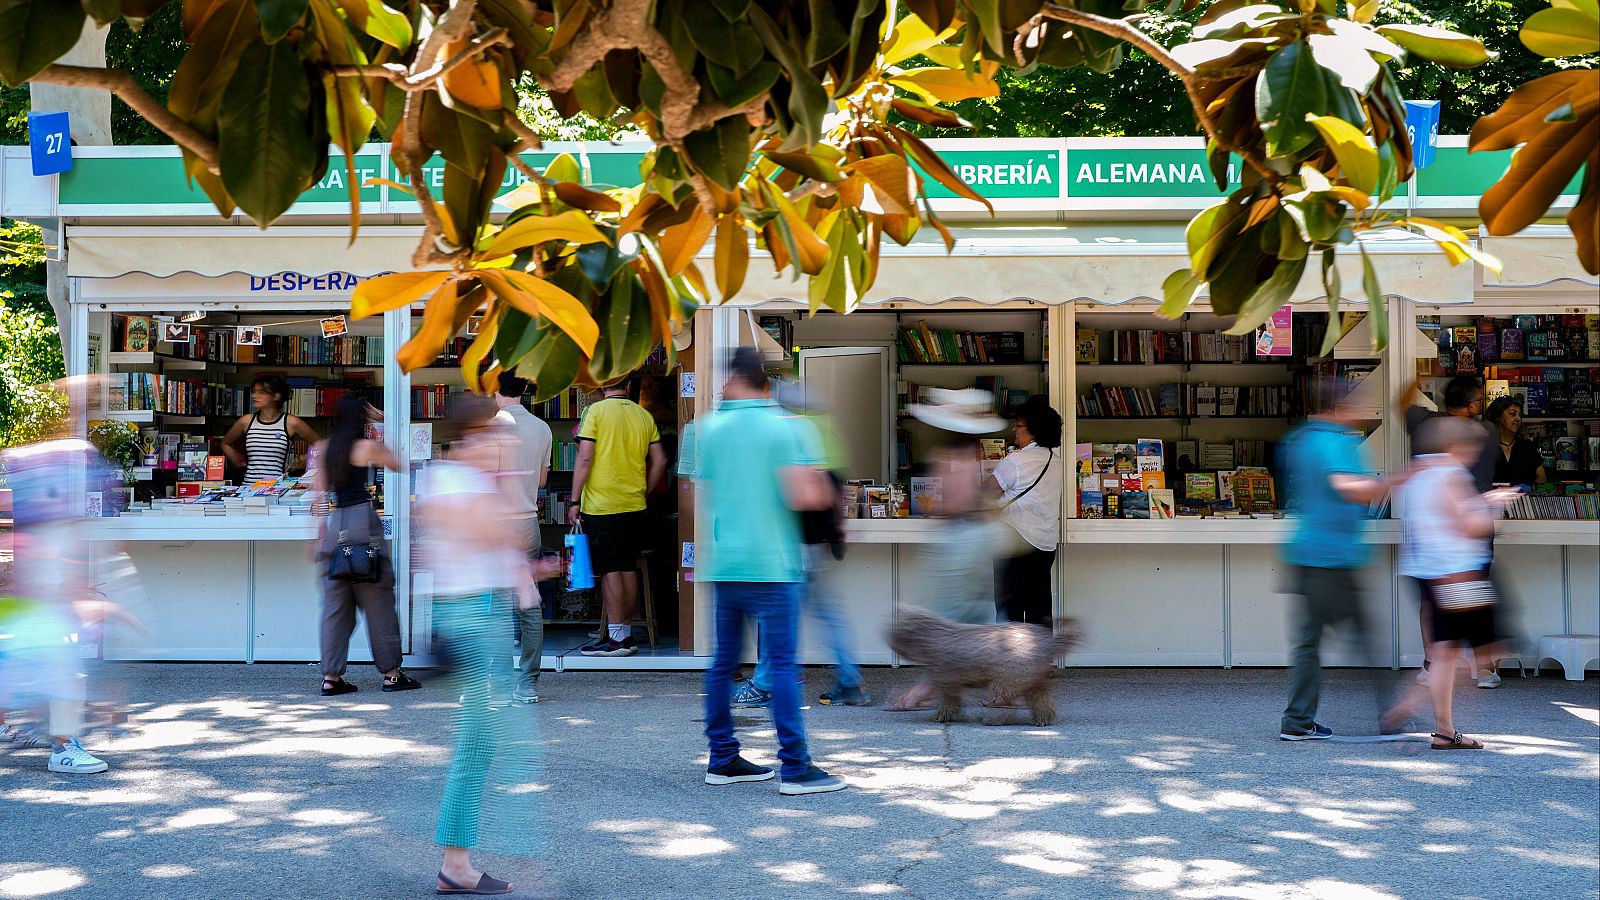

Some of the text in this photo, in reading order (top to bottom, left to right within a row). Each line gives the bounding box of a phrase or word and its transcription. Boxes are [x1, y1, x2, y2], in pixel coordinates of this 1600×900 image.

[46, 132, 63, 155] 27
[938, 158, 1053, 185] IBRERÍA
[1075, 162, 1207, 184] ALEMANA
[250, 271, 372, 291] DESPERA
